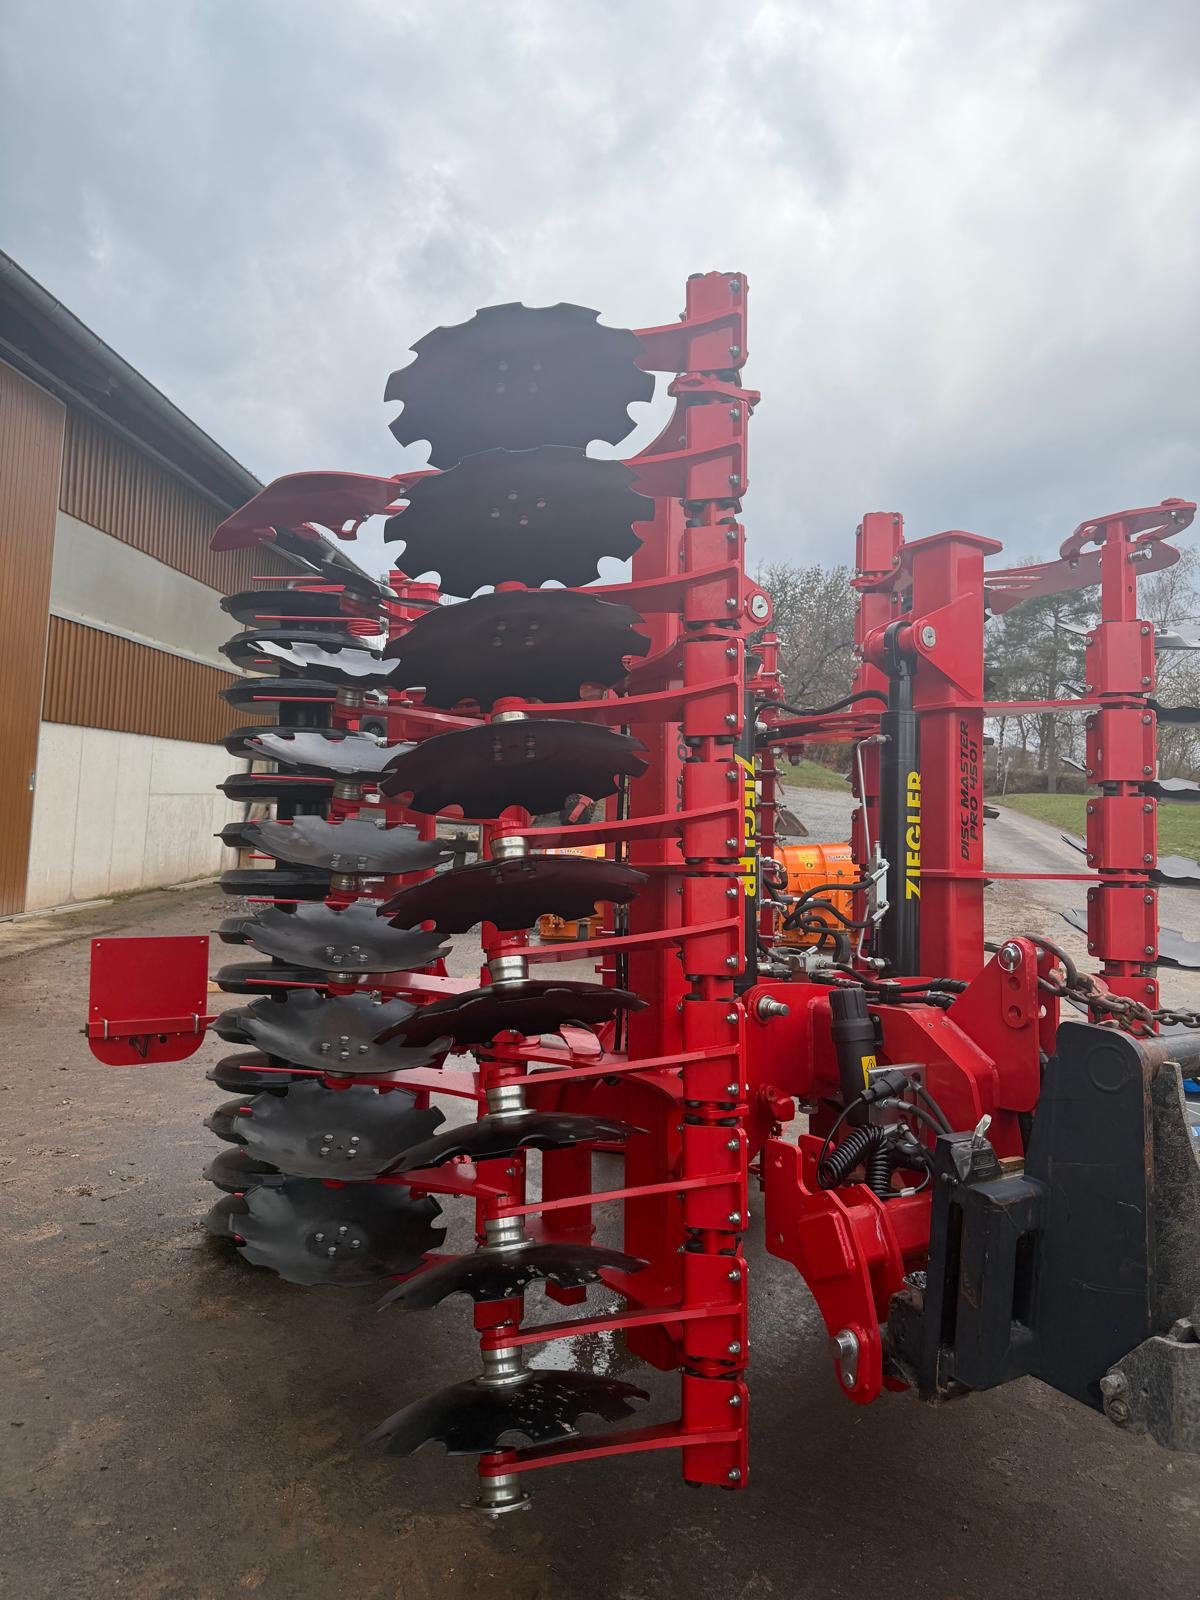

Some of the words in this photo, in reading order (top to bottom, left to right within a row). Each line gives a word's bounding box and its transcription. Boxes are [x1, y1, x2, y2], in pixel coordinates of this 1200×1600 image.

[959, 720, 970, 809] MASTER
[969, 740, 978, 790] 4501
[960, 813, 970, 861] DISC
[969, 796, 978, 841] PRO
